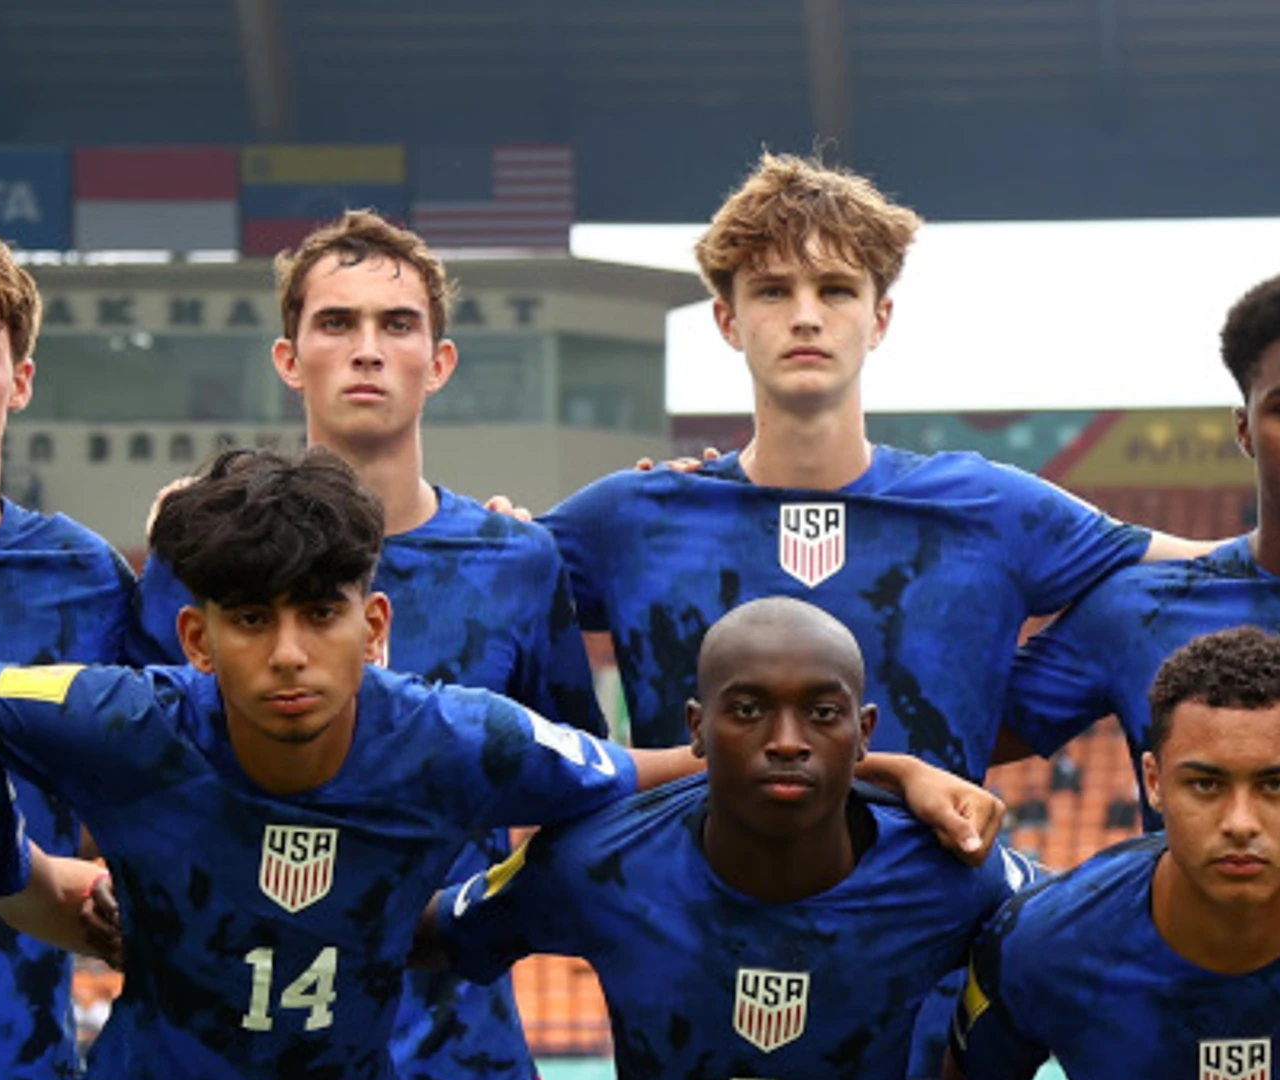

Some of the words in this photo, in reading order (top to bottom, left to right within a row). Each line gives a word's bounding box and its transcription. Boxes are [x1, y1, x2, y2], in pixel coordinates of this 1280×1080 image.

[784, 507, 840, 538] USA
[269, 831, 333, 863] USA
[240, 946, 338, 1032] 14
[741, 974, 804, 1006] USA
[1203, 1044, 1266, 1076] USA
